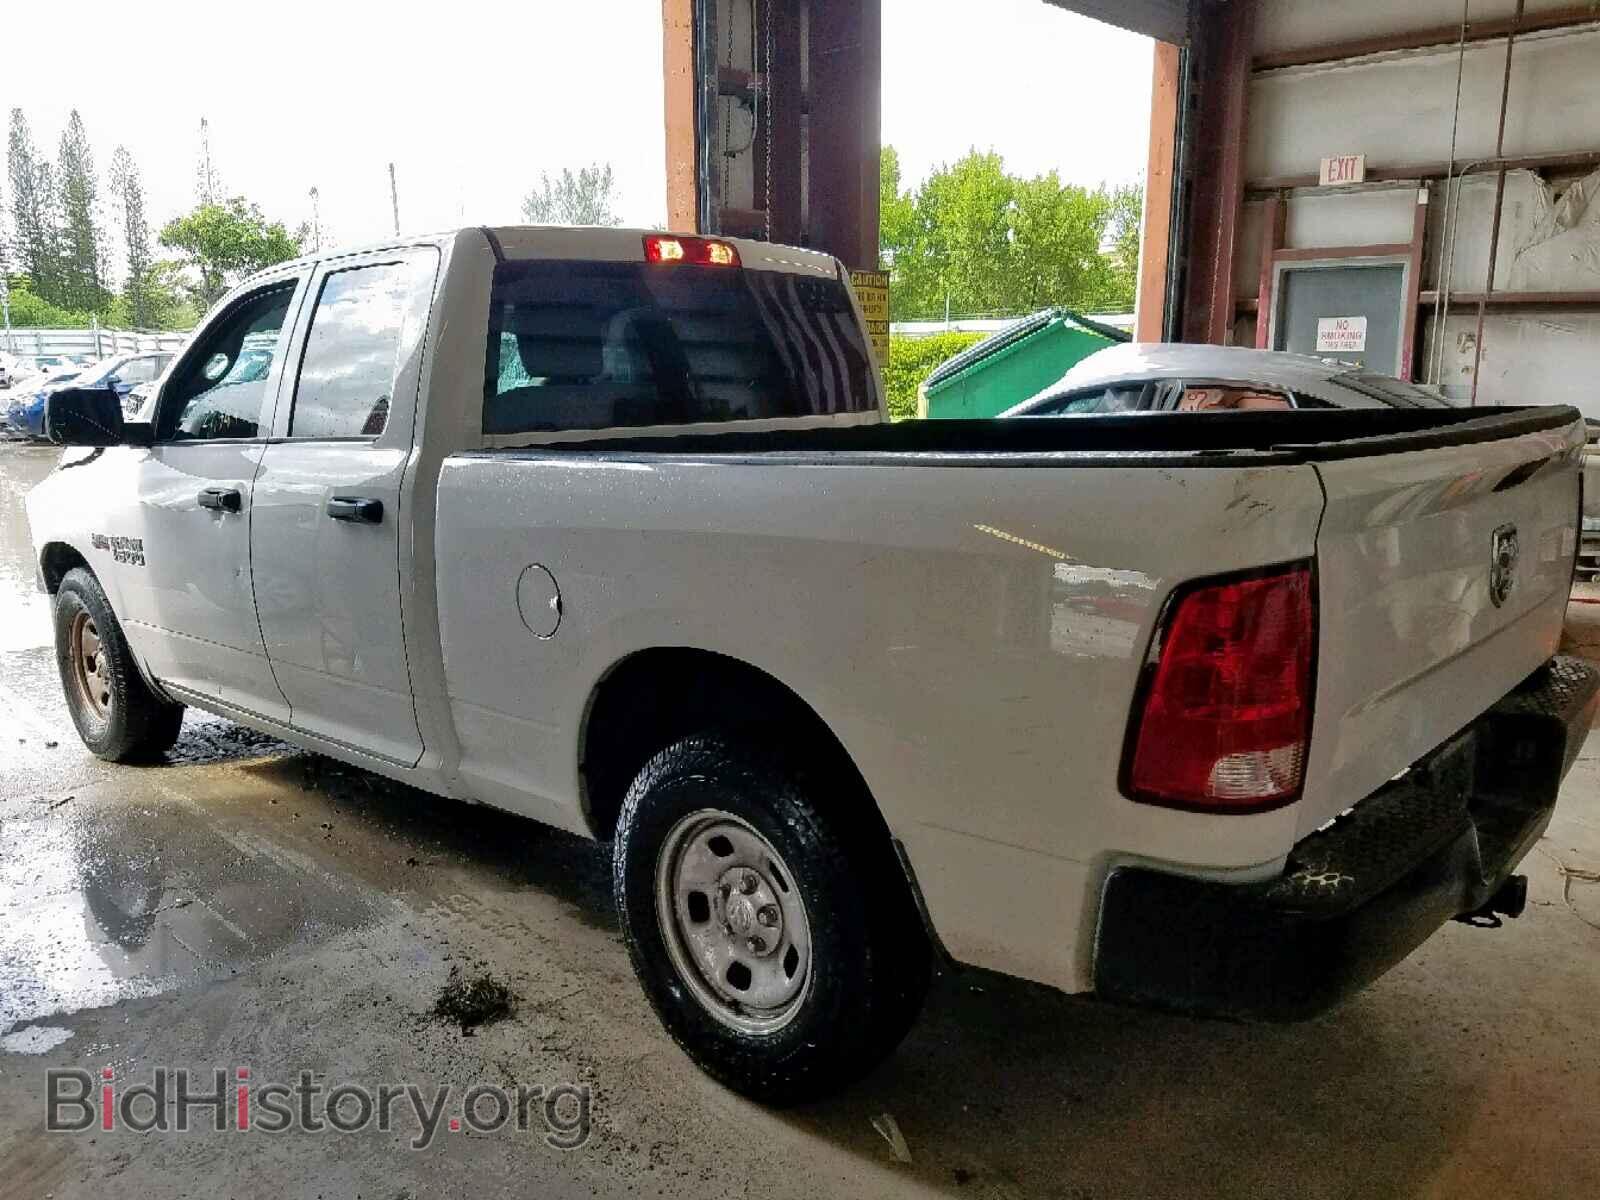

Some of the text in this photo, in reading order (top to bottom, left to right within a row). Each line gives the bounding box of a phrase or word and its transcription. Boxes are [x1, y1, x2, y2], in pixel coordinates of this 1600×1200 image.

[1328, 157, 1357, 181] EXIT
[851, 273, 888, 287] CAUTION
[1336, 320, 1349, 329] NO
[1321, 331, 1361, 340] SMOKING
